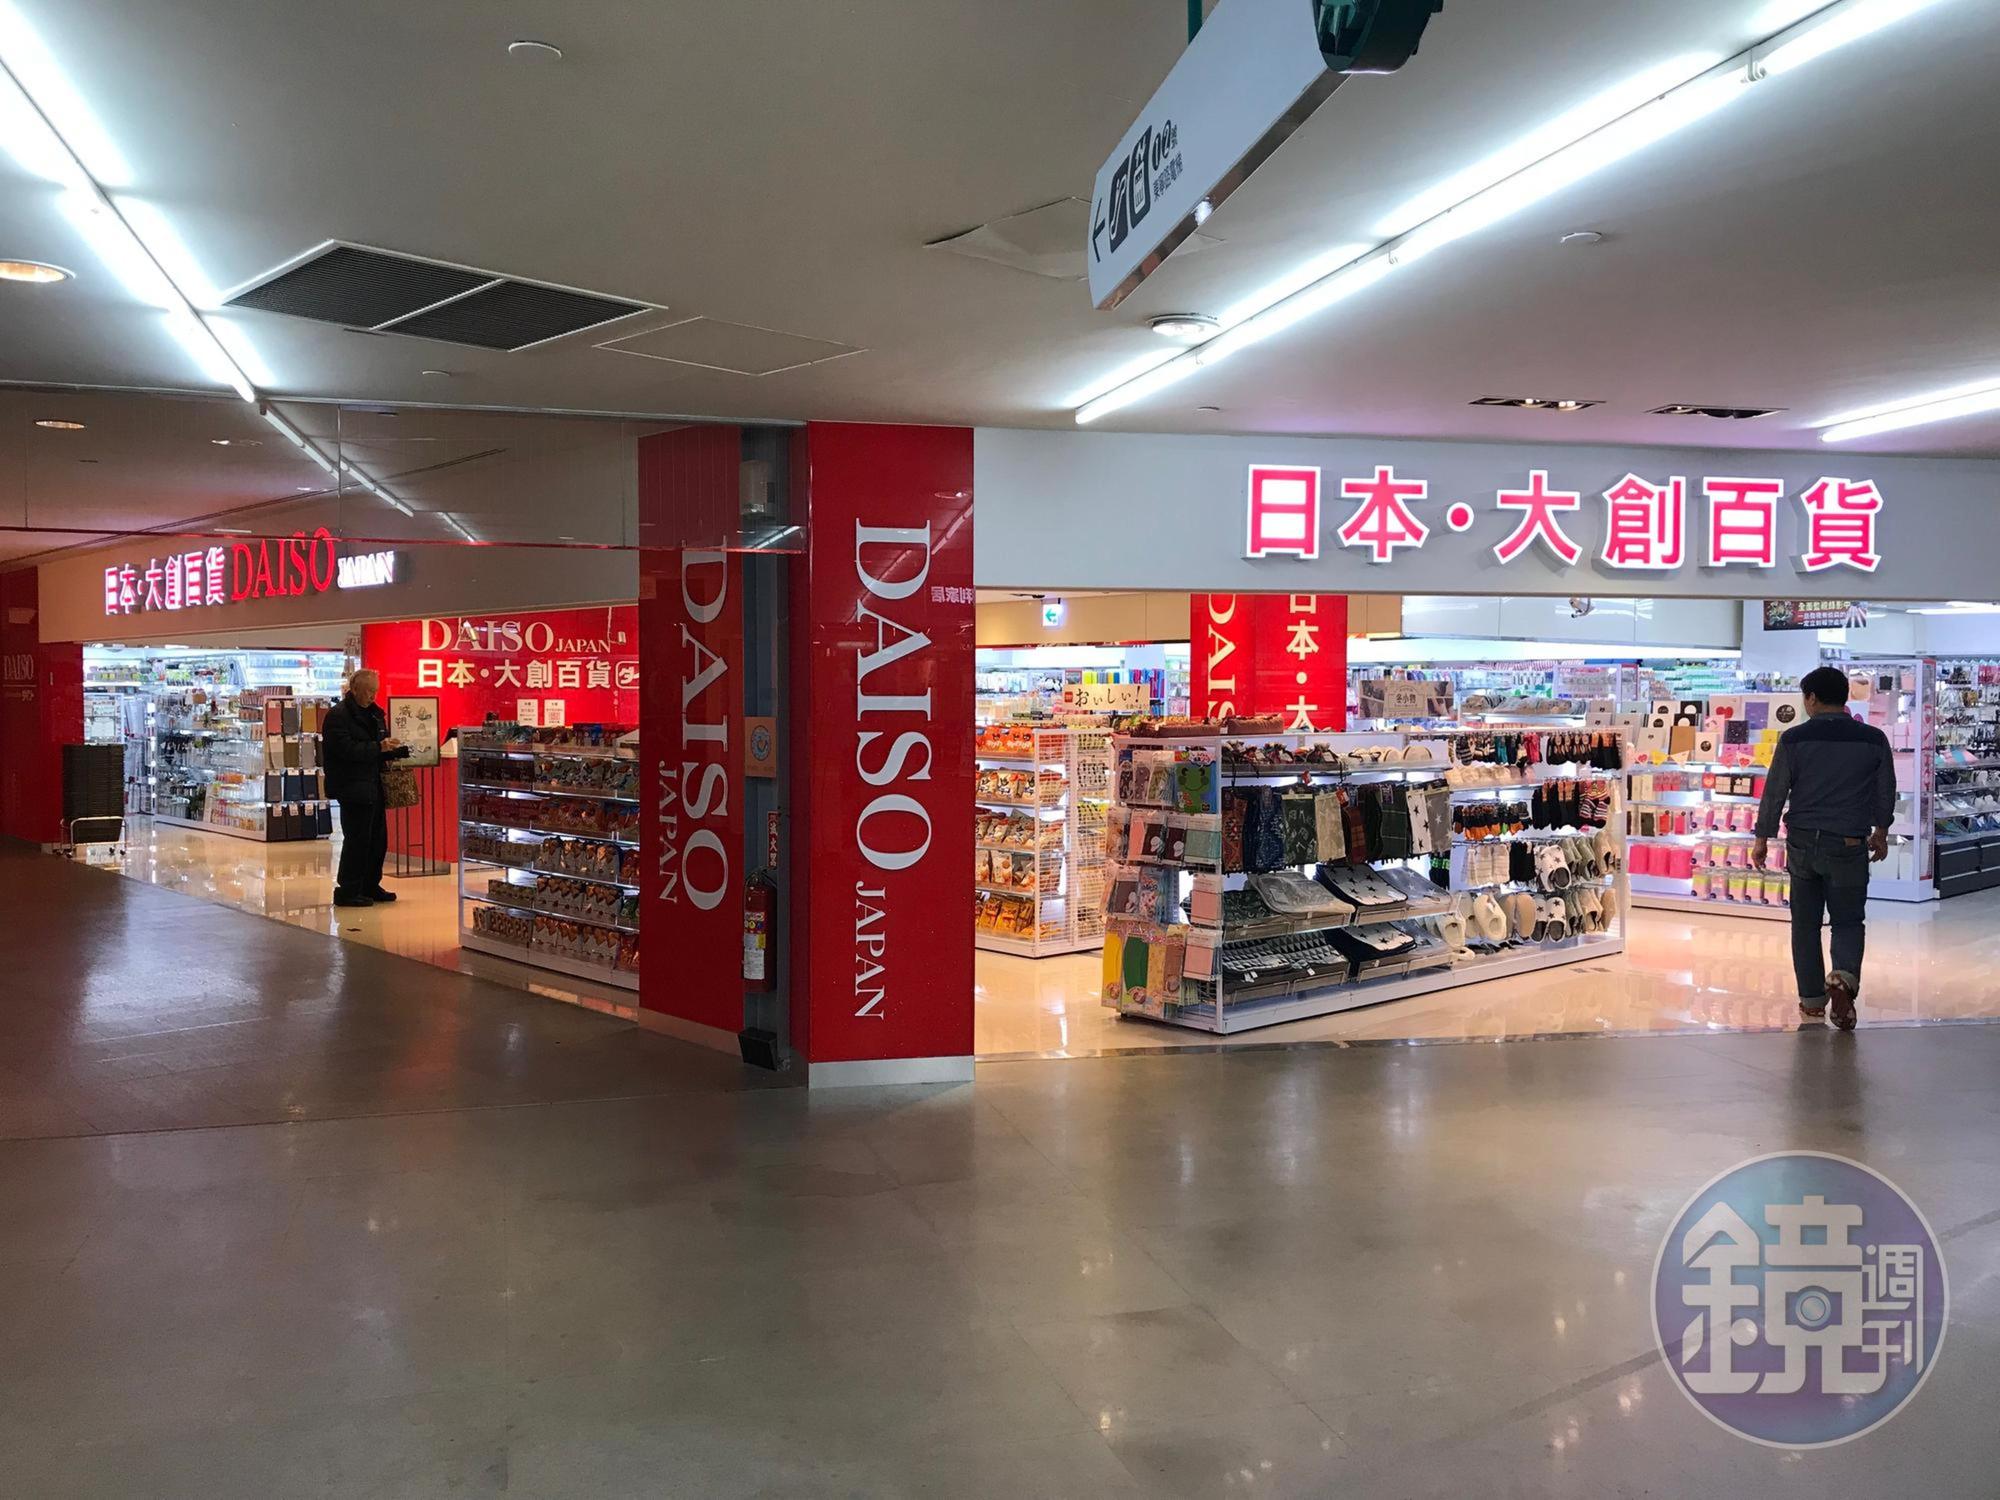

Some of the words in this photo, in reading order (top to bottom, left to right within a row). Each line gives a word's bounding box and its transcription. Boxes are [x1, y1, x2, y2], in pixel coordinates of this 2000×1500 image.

[231, 527, 336, 600] DAISO
[1245, 463, 1884, 572] 日本・大創百貨
[417, 658, 612, 689] 日本・大創百貨
[418, 618, 554, 653] DAISO
[555, 637, 611, 654] JAPAN
[856, 518, 932, 872] DAISO
[681, 535, 729, 911] DAISO
[659, 760, 678, 905] JAPAN
[855, 880, 885, 1020] JAPAN
